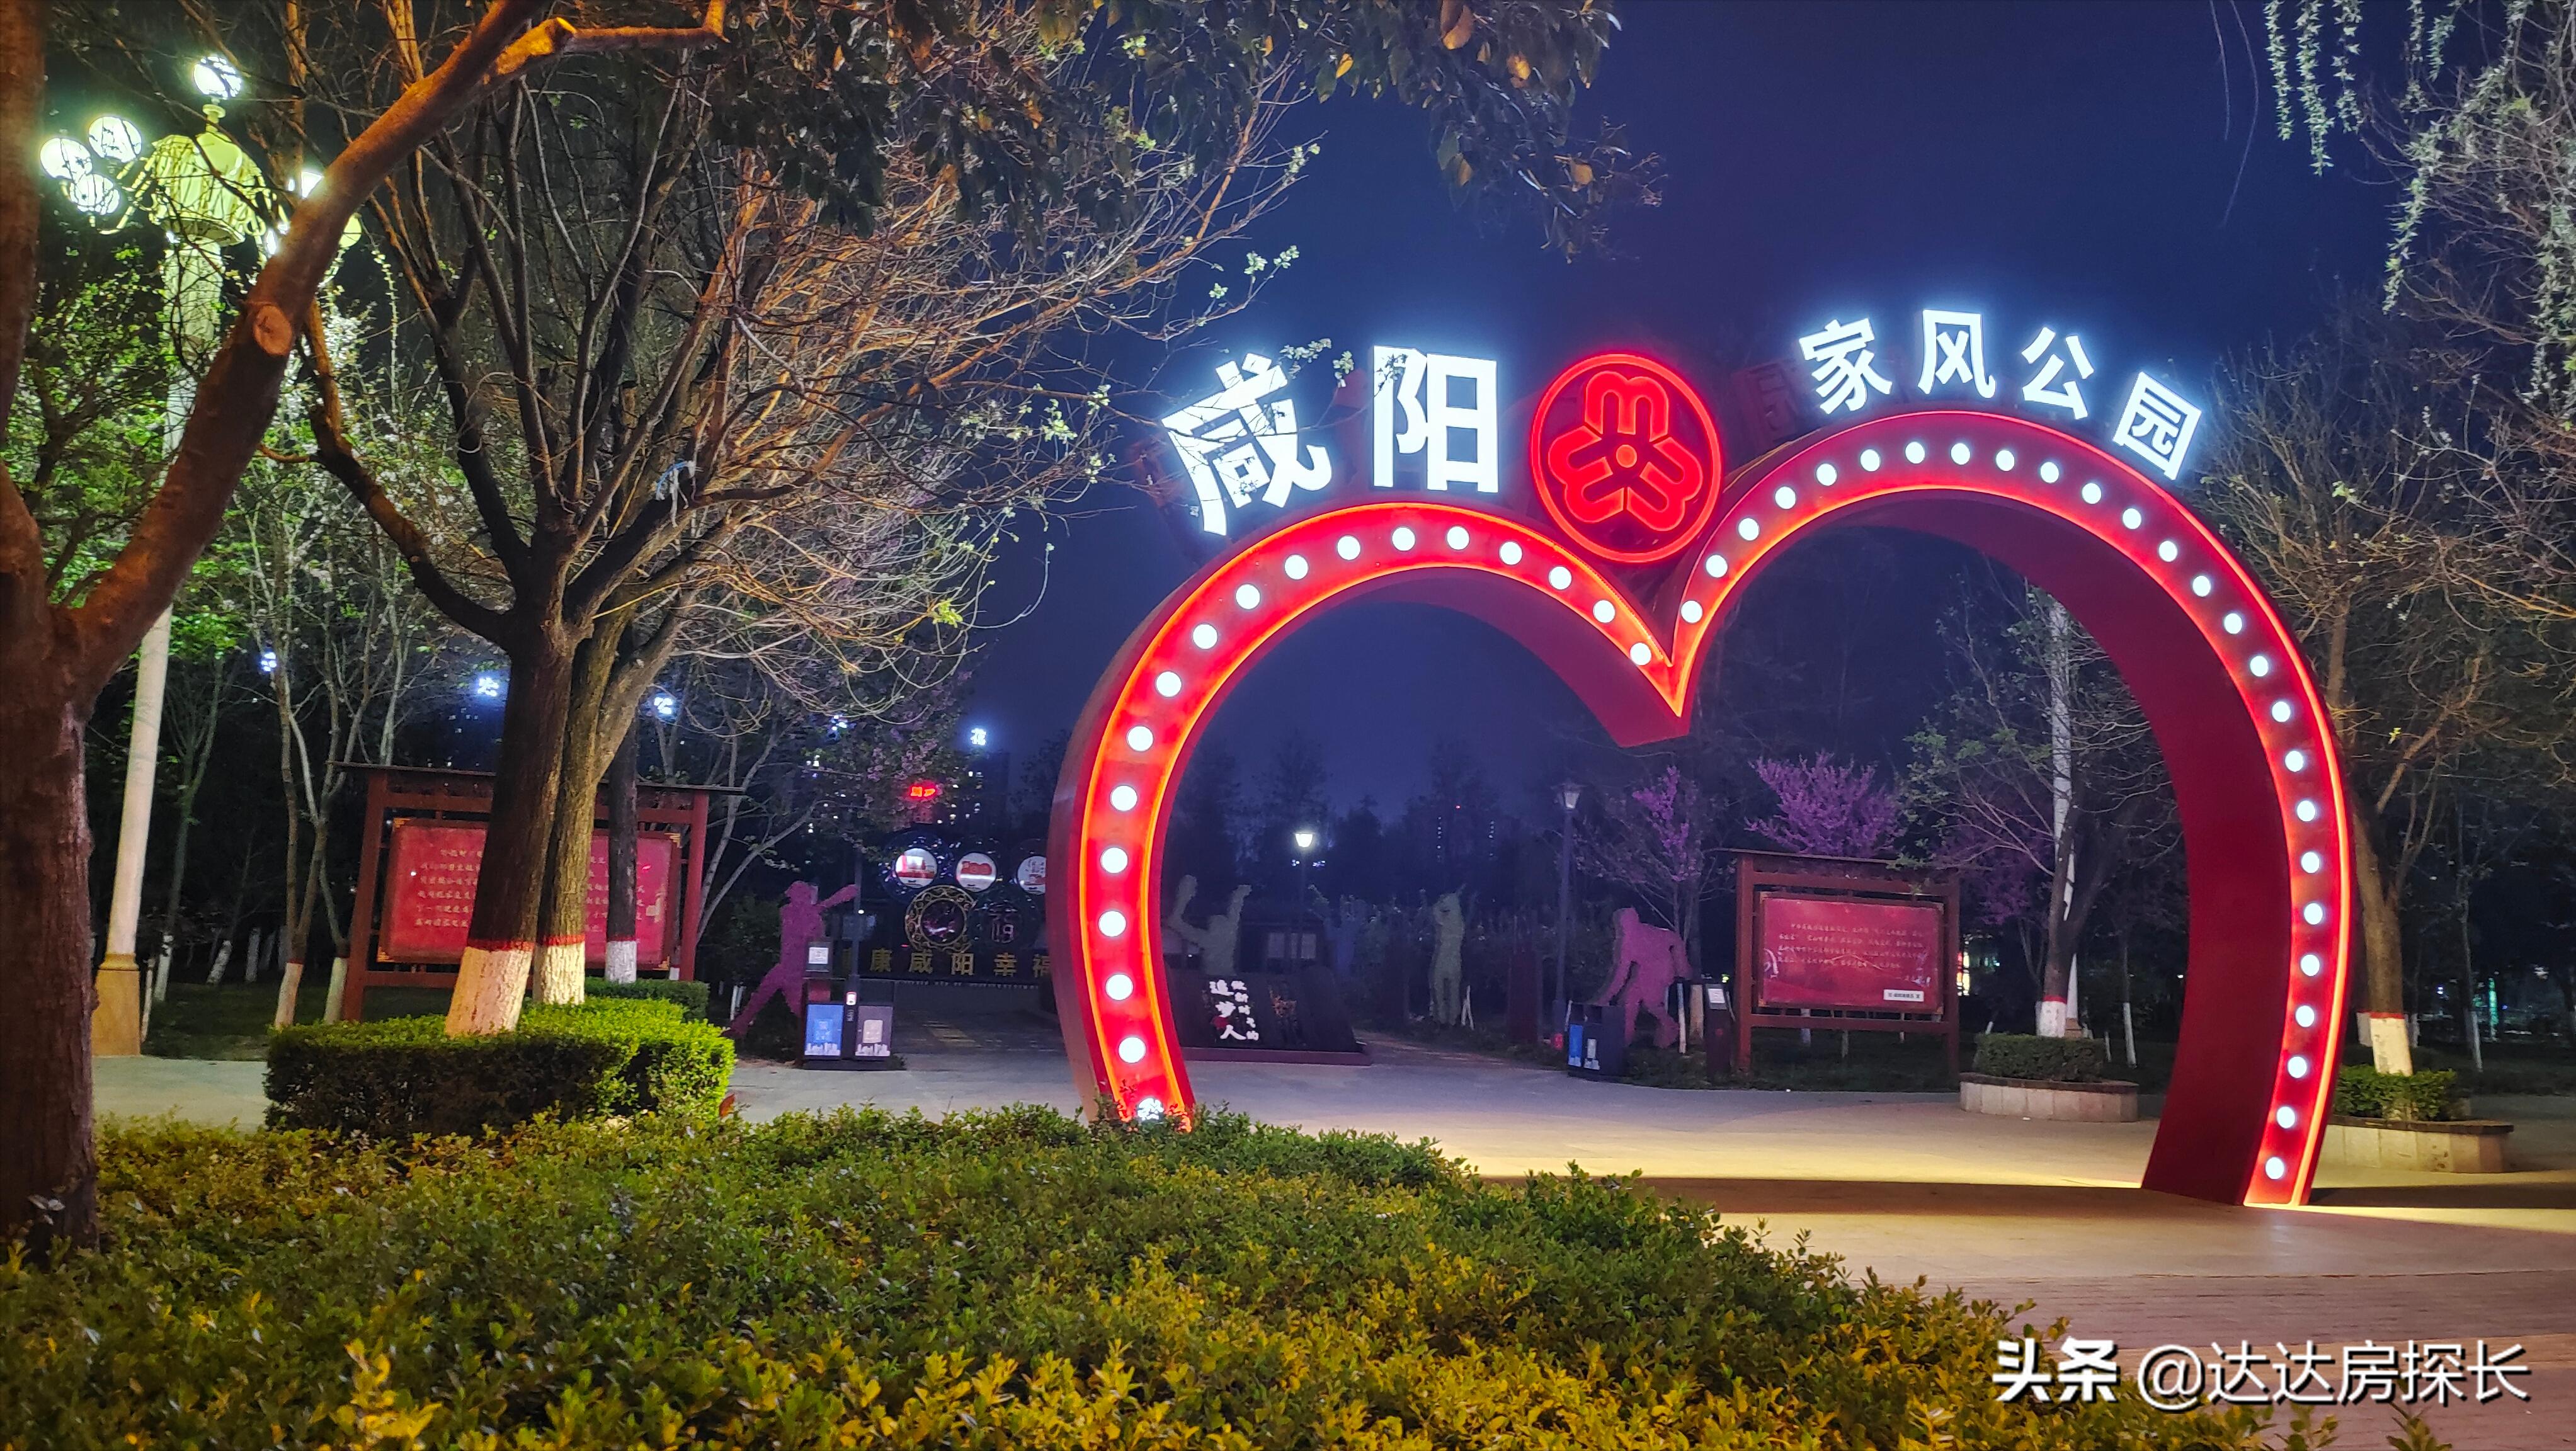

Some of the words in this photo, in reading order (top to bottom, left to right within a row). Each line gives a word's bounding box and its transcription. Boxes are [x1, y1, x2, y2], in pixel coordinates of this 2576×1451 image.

[1161, 345, 1498, 535] 咸阳
[1799, 309, 2202, 480] 家风公园
